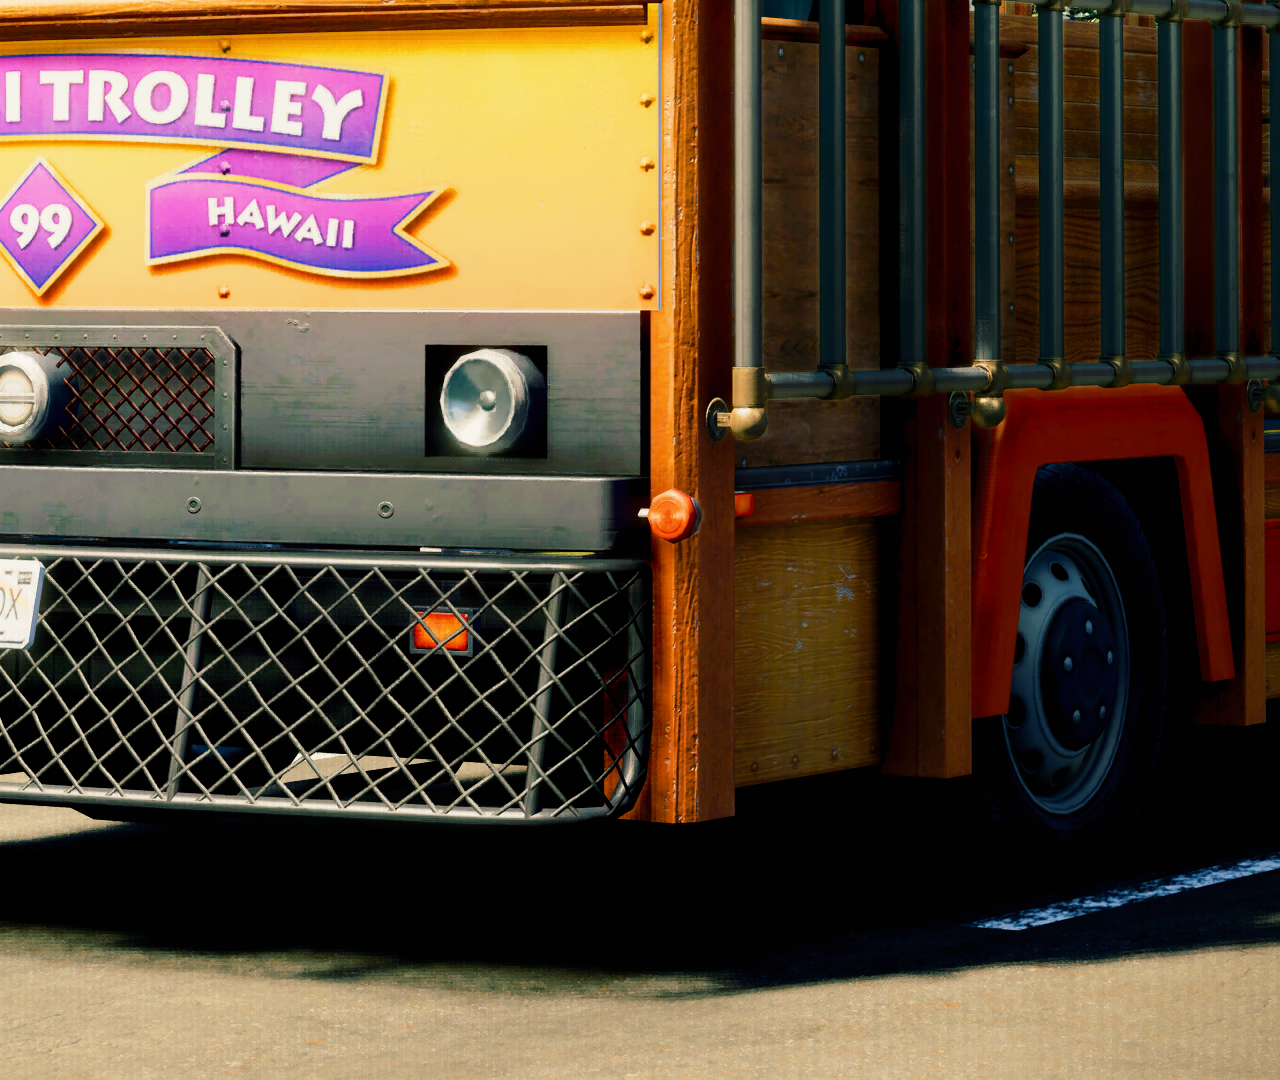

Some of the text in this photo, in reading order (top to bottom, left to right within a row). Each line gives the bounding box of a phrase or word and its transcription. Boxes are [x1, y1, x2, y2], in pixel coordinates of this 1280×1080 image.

[39, 70, 364, 142] TROLLEY
[8, 202, 72, 251] 99
[207, 196, 356, 249] HAWAII
